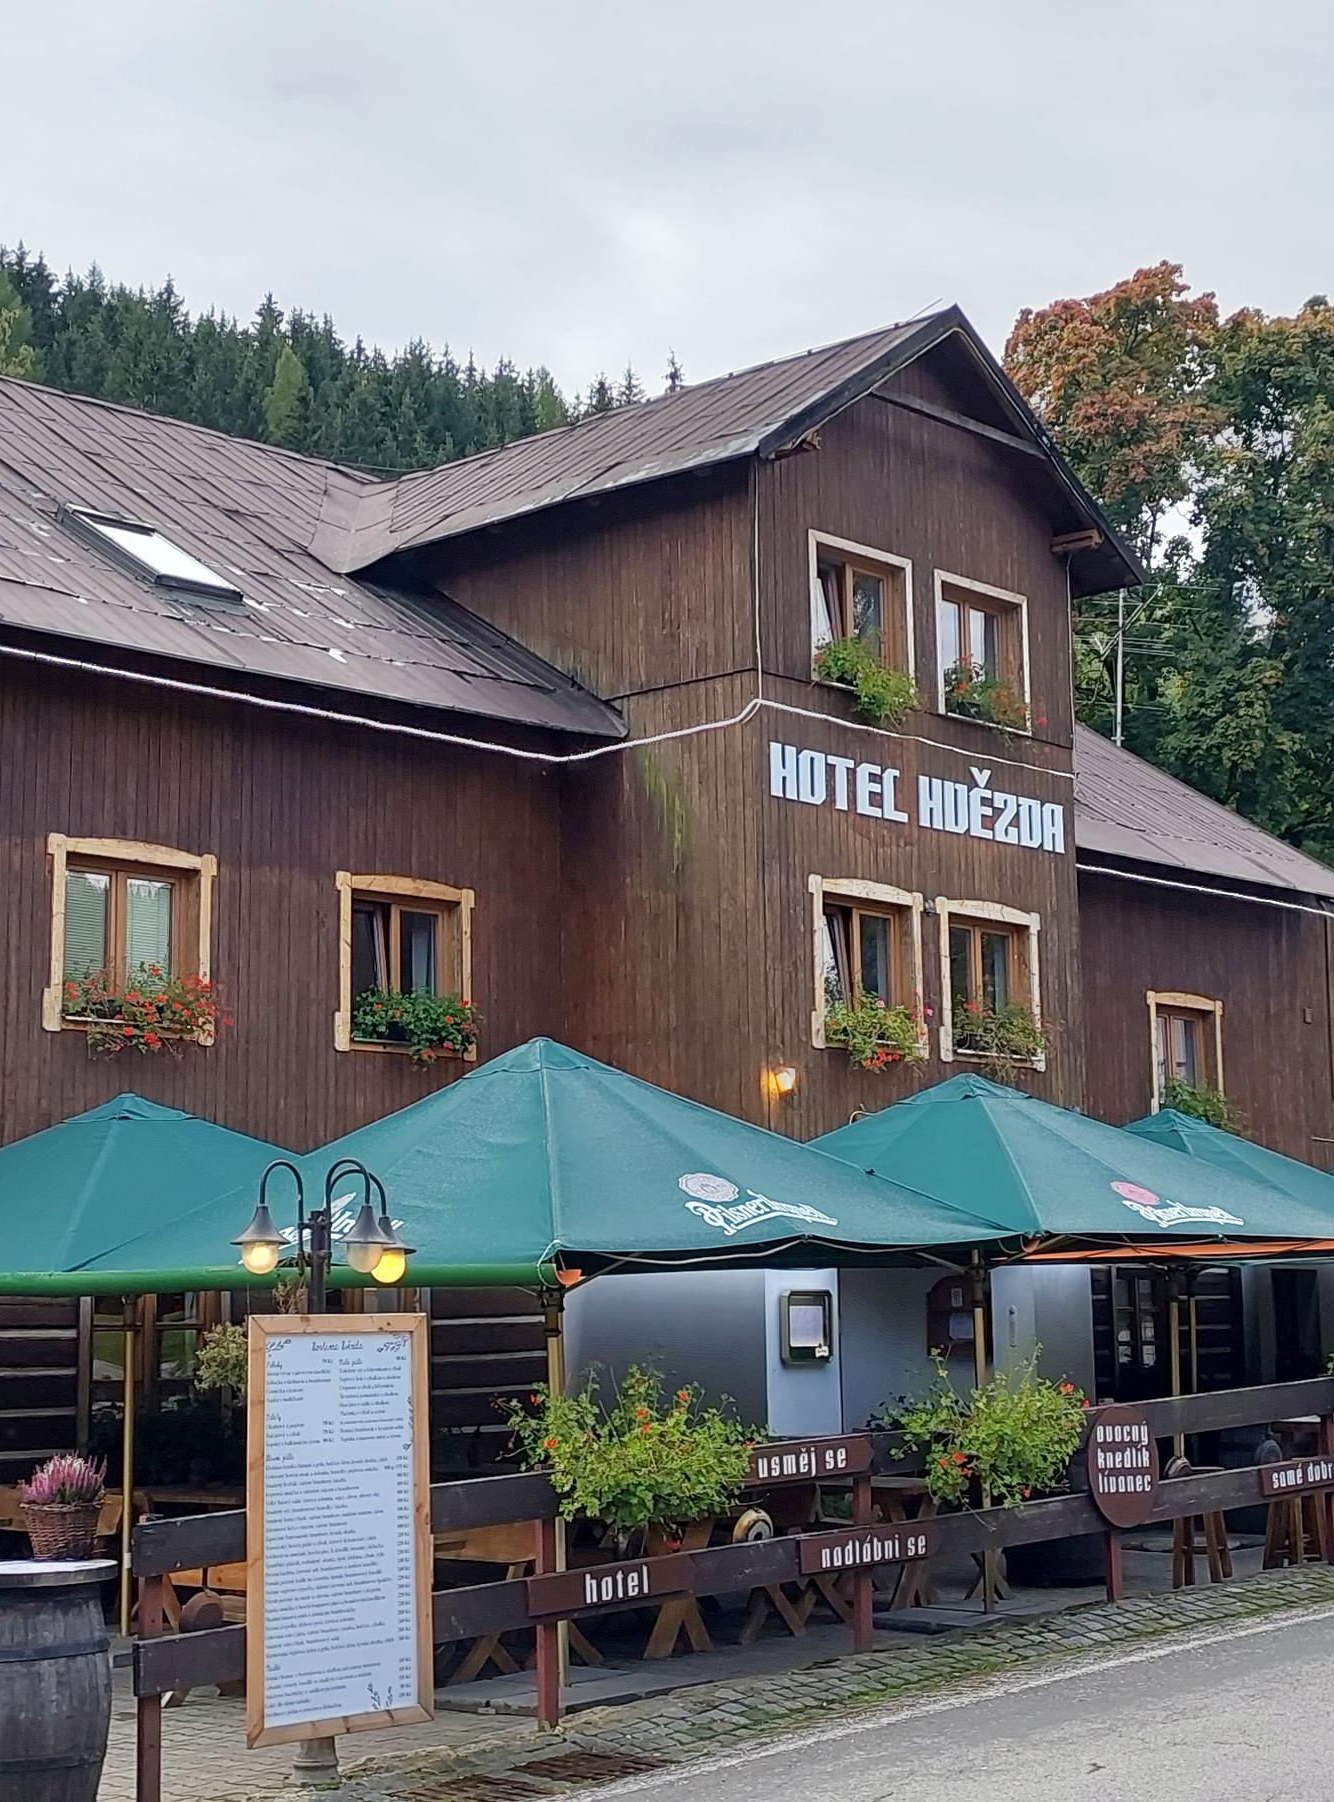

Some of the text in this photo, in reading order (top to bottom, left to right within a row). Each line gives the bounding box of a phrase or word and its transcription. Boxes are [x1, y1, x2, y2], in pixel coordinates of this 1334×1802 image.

[768, 741, 1066, 855] HOTEL HVĚZDA
[684, 1199, 770, 1236] Pilsner
[1096, 1420, 1149, 1446] ovocný
[757, 1446, 847, 1479] usměj se
[1097, 1443, 1150, 1469] knedlík
[1098, 1469, 1152, 1494] lívanec
[1272, 1462, 1303, 1489] samé
[821, 1533, 927, 1569] nadlábni se
[584, 1563, 650, 1604] hotel
